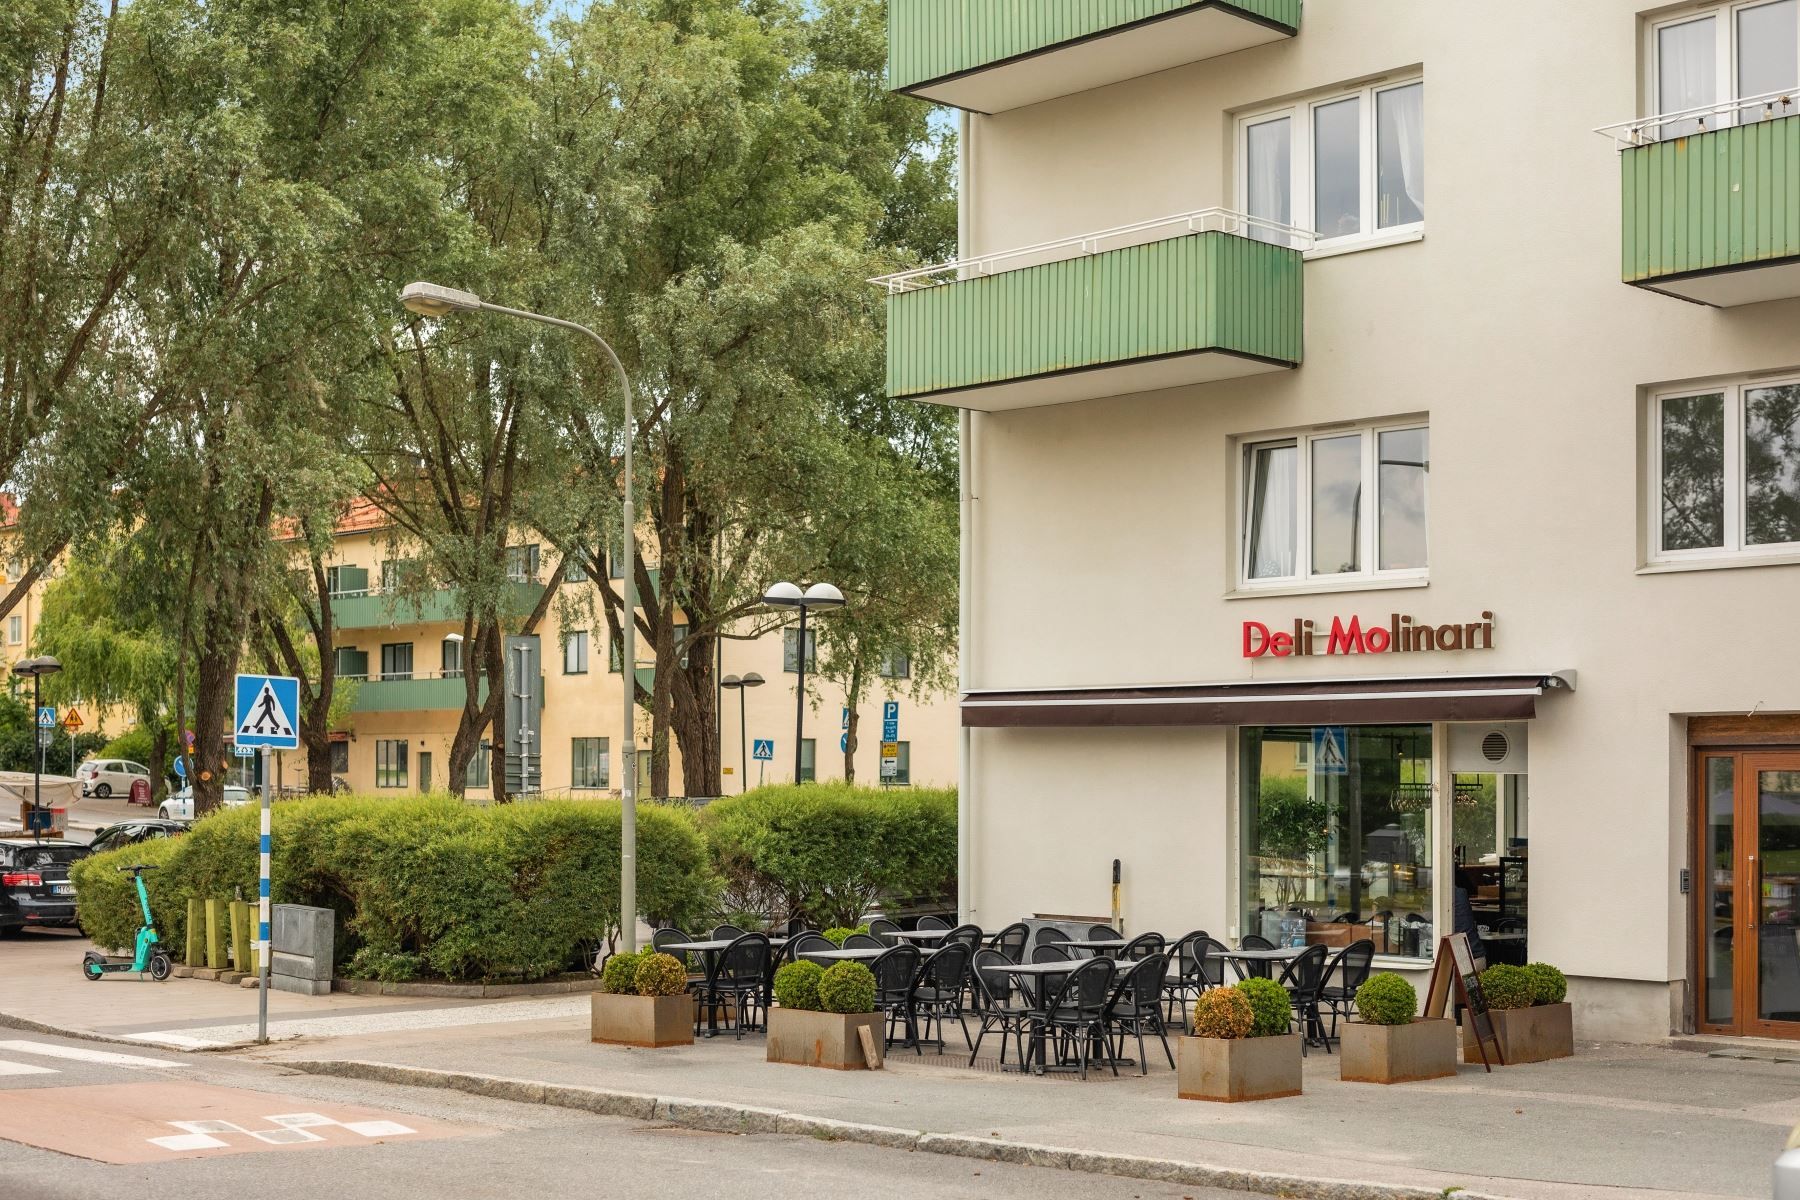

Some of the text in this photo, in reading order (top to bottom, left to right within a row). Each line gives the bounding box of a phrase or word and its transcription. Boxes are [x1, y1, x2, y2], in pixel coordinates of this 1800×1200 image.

[1243, 611, 1493, 658] Deli Molinari
[887, 703, 896, 719] P
